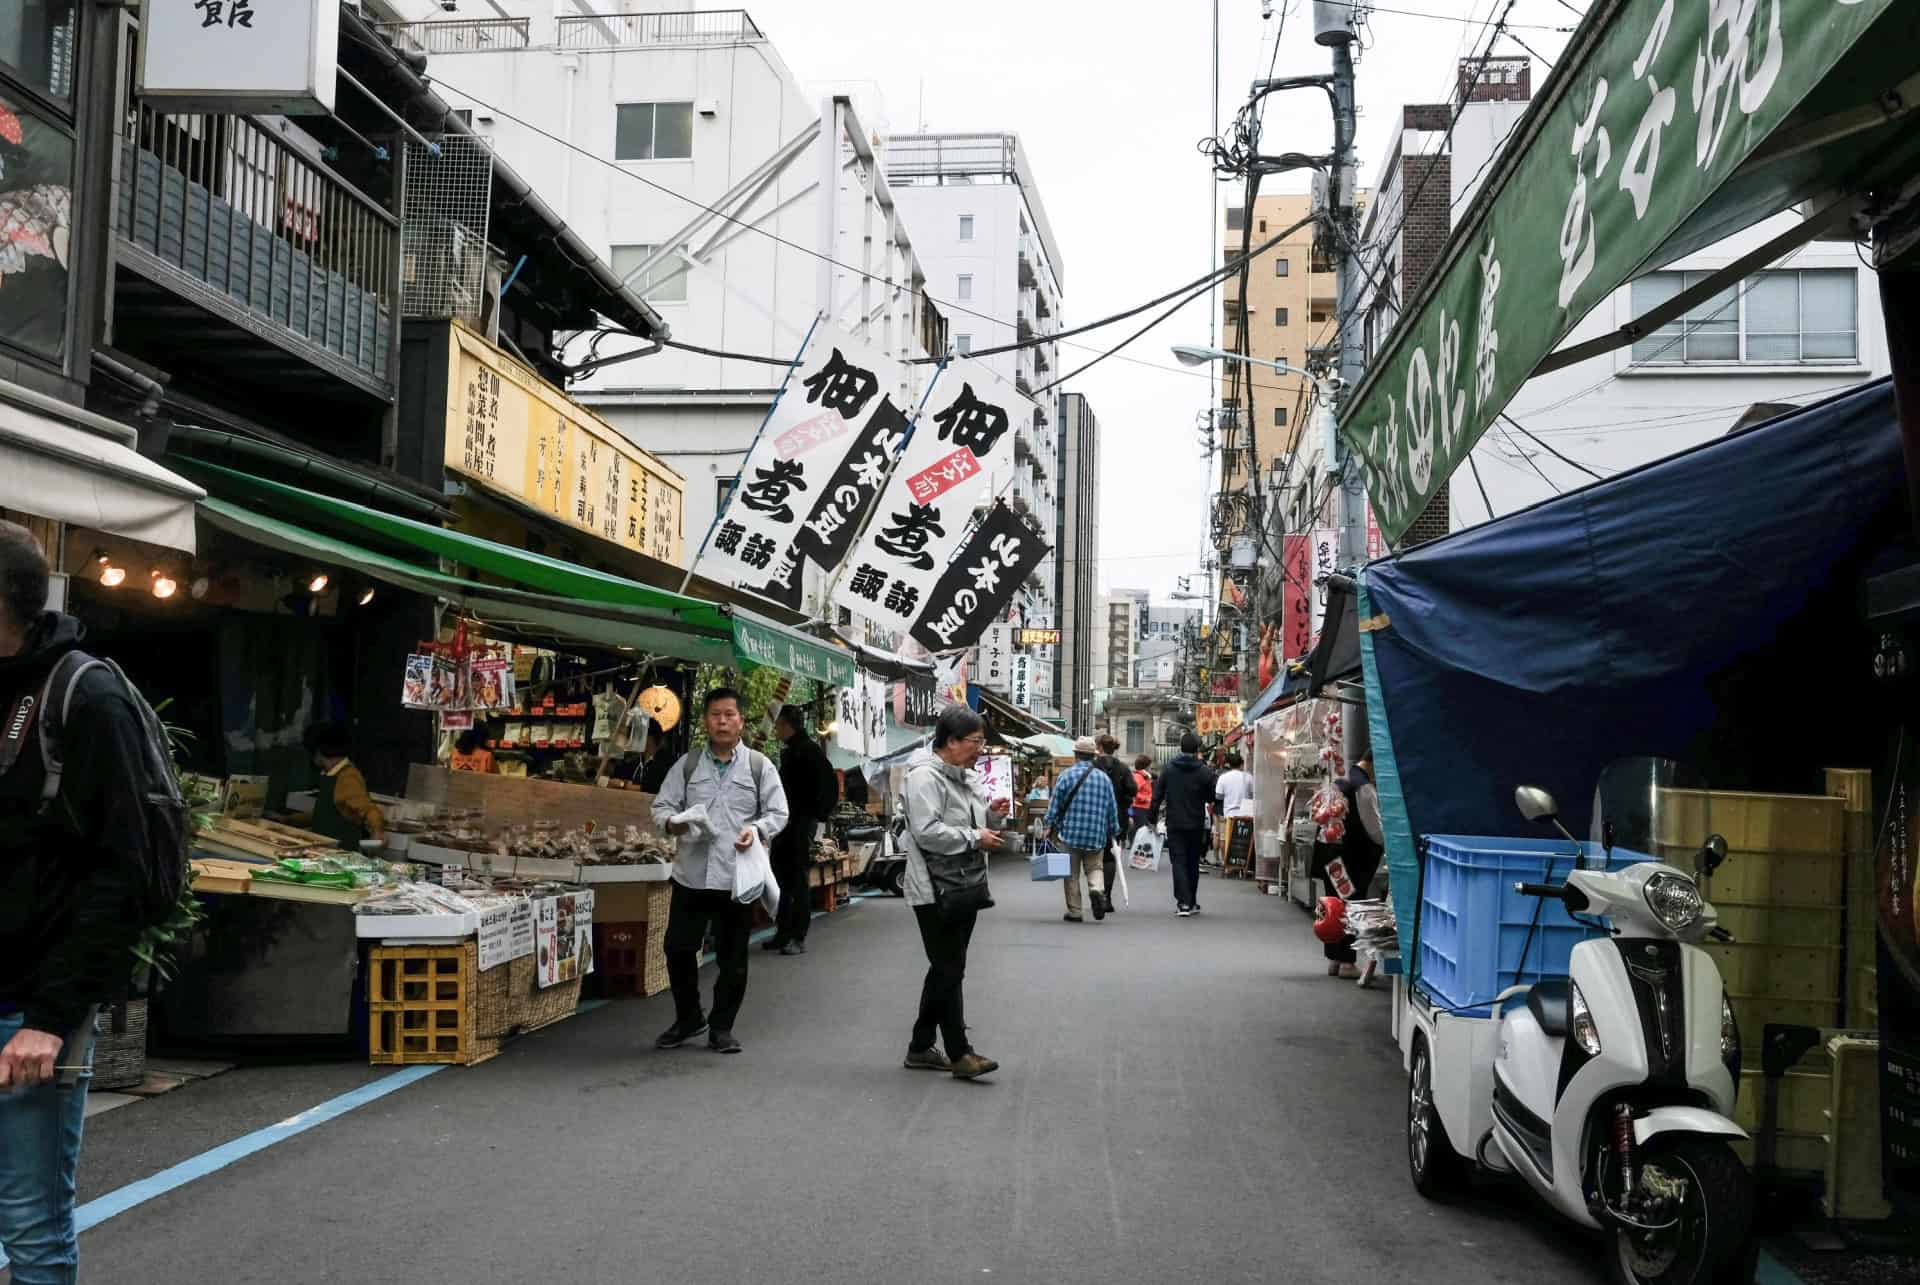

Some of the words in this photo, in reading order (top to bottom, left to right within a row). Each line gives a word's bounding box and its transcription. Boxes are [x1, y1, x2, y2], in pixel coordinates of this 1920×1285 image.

[741, 347, 880, 525] 佃煮
[874, 381, 1010, 571] 佃煮
[913, 450, 974, 499] 江戸前
[714, 519, 777, 570] 諏訪
[849, 563, 920, 618] 諏訪
[8, 695, 35, 739] Canon
